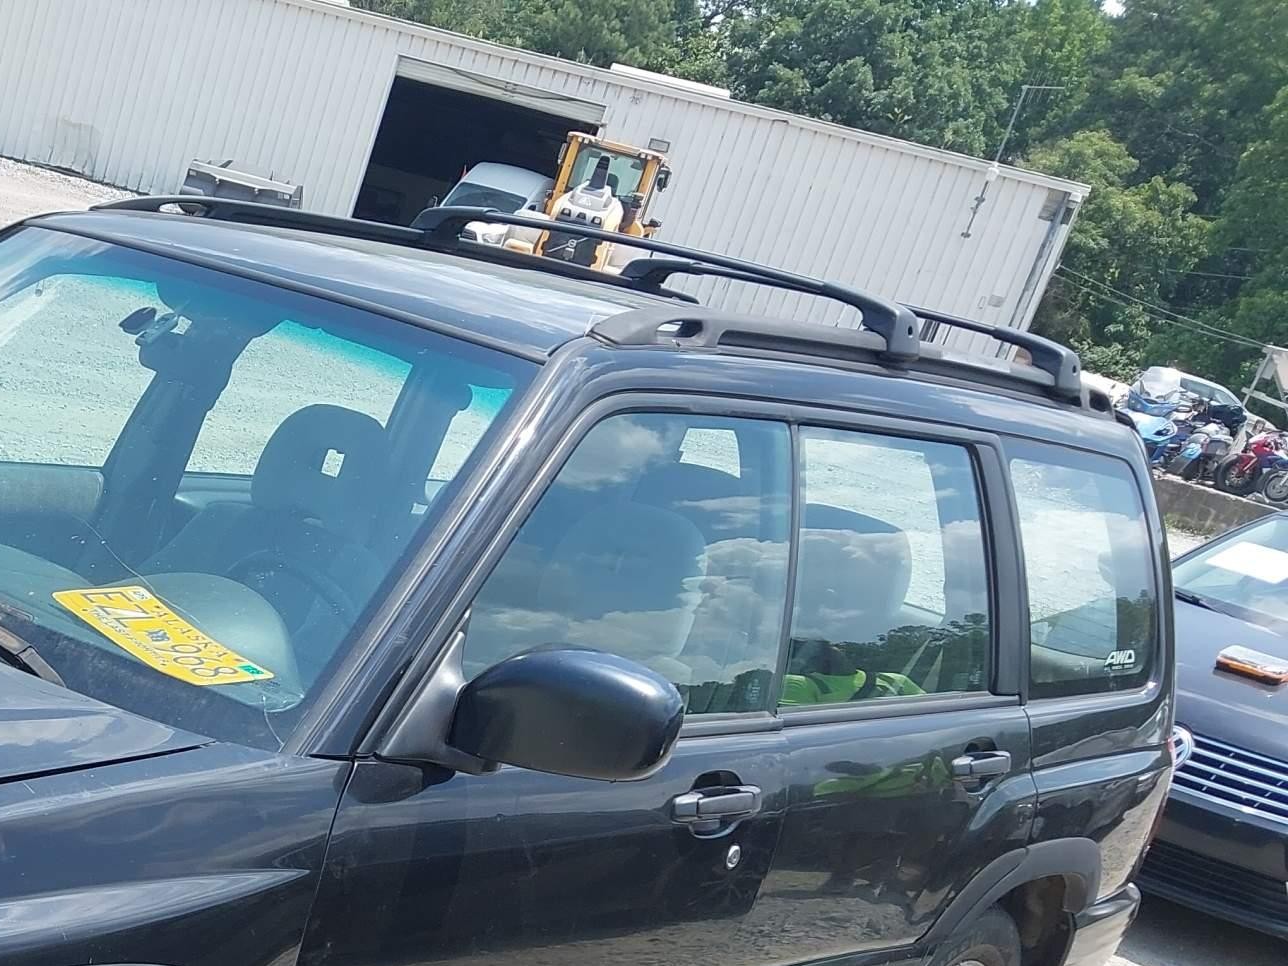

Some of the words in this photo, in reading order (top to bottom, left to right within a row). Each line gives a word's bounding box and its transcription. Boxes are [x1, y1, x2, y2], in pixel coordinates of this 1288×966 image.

[80, 591, 155, 628] EZL
[153, 643, 239, 678] 968
[152, 607, 229, 658] ALASKA
[1104, 649, 1135, 666] AWD
